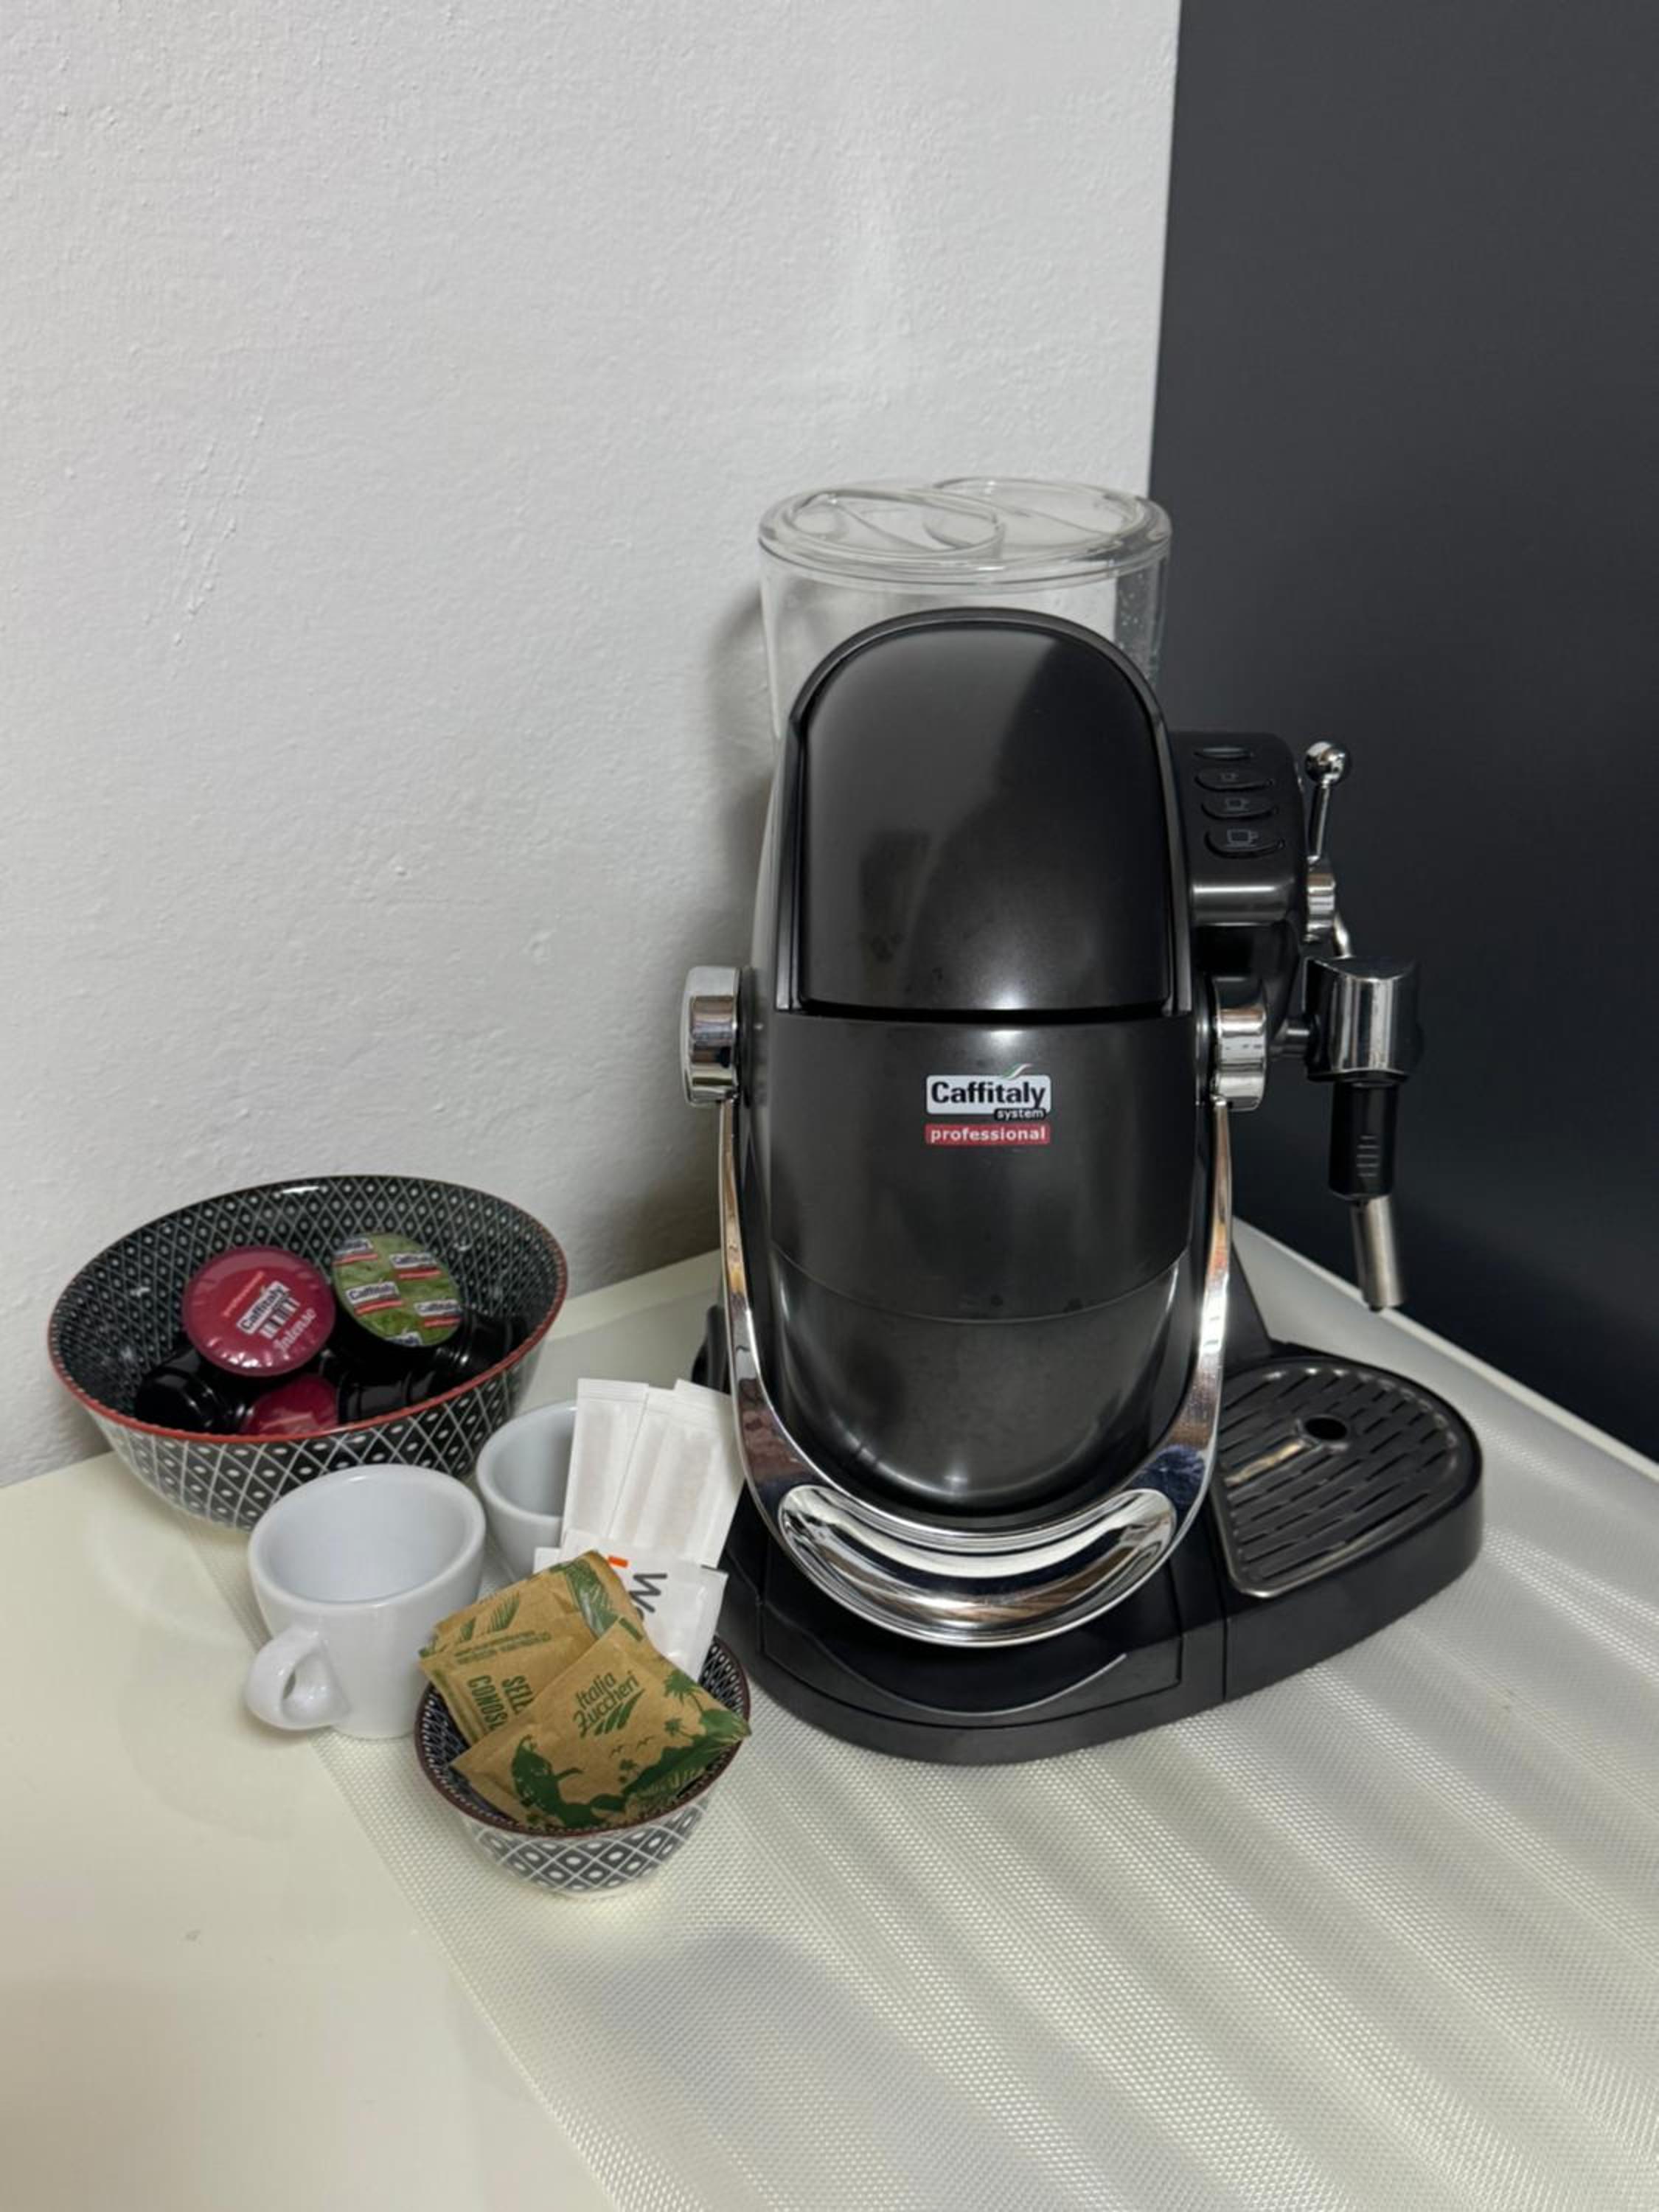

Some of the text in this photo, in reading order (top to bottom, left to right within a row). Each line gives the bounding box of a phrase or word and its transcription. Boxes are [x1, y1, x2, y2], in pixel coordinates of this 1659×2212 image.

[931, 1080, 1046, 1110] Caffitaly
[997, 1108, 1045, 1121] system
[930, 1126, 1046, 1144] professional
[240, 1284, 285, 1331] Caffitaly
[627, 1573, 667, 1621] W
[572, 1670, 640, 1739] Zuccheri
[575, 1672, 617, 1710] Italia
